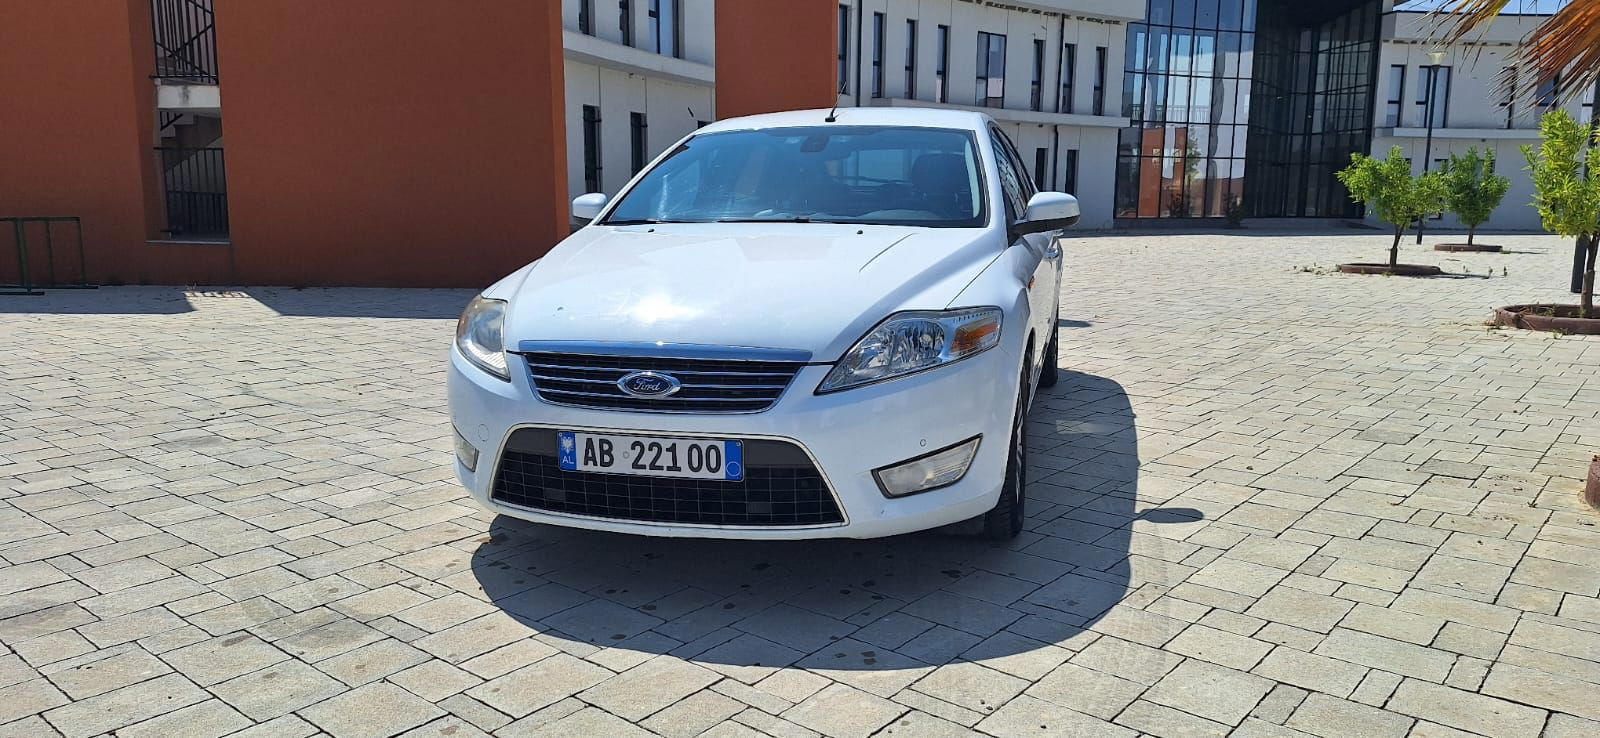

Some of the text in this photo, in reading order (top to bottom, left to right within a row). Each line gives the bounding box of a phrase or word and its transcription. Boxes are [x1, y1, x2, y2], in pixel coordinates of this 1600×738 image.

[634, 378, 660, 391] Ford
[583, 437, 615, 467] AB
[562, 455, 574, 465] AL
